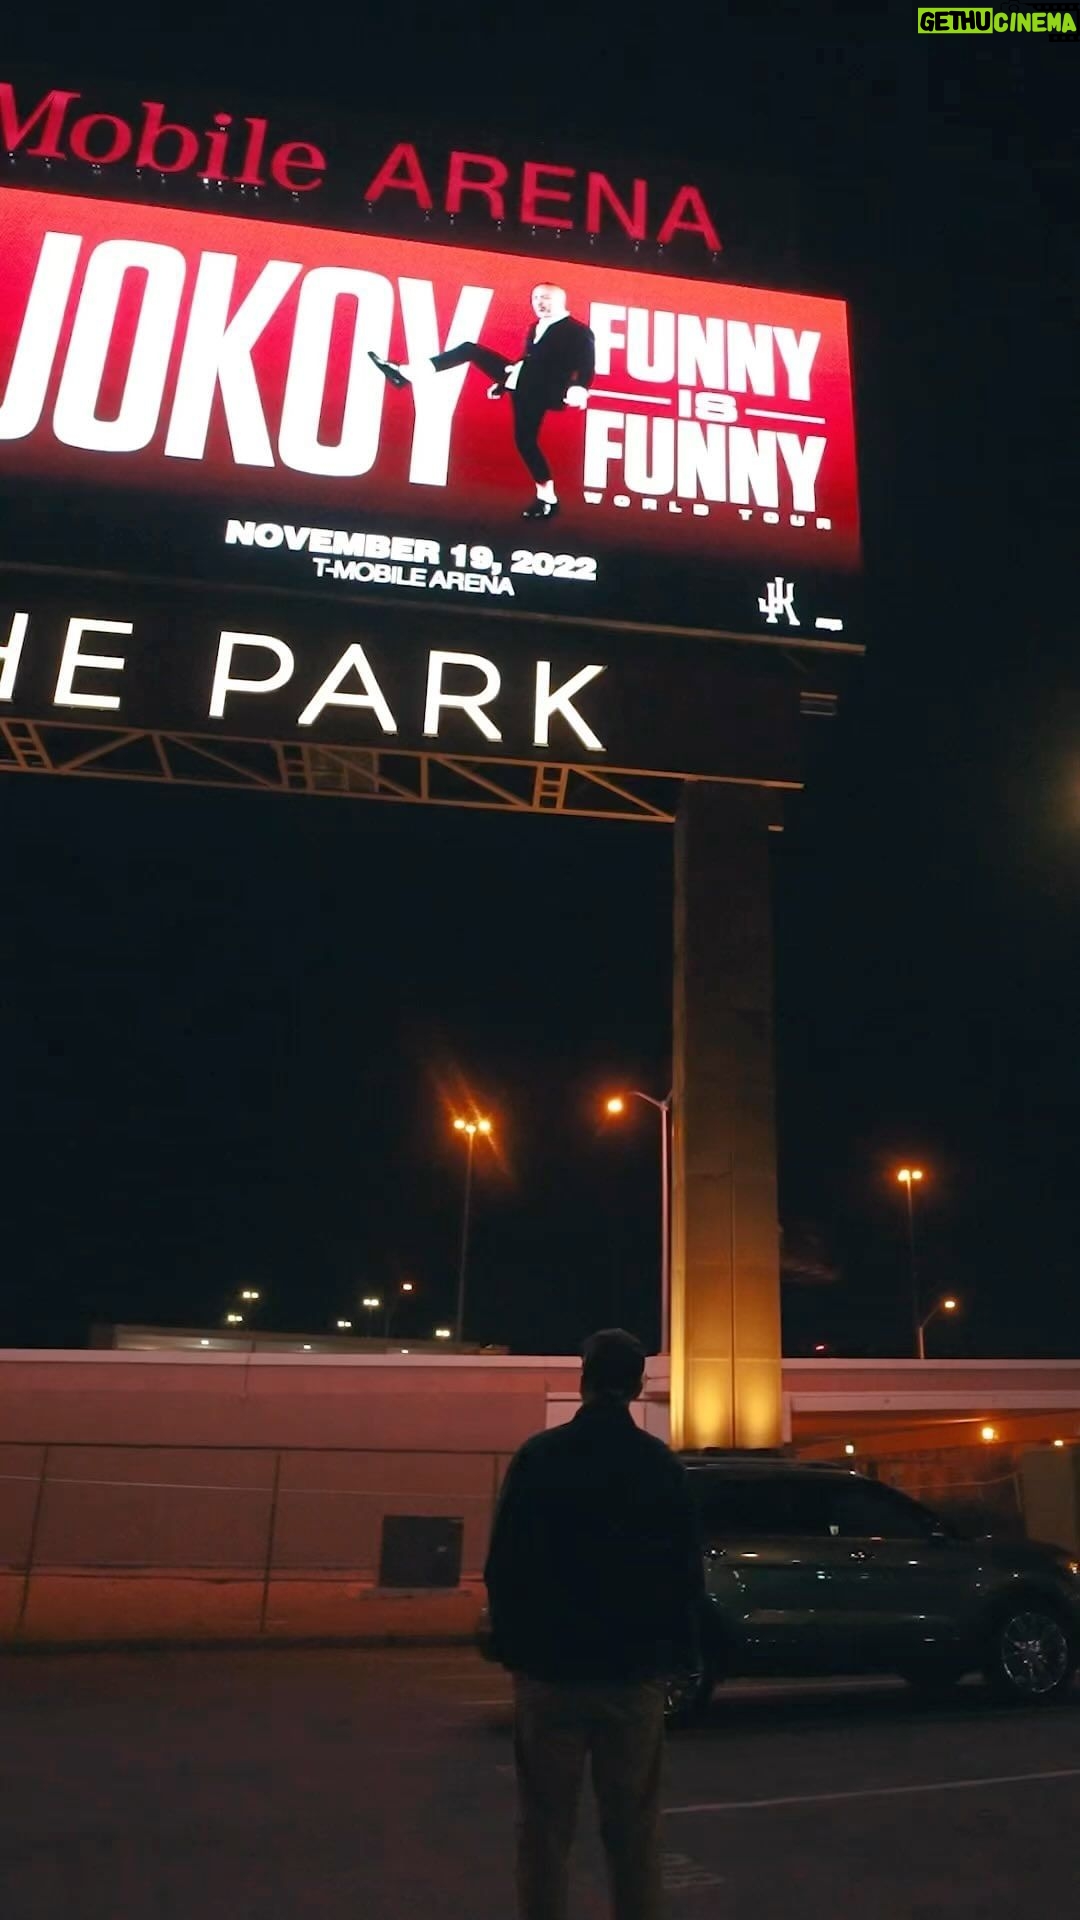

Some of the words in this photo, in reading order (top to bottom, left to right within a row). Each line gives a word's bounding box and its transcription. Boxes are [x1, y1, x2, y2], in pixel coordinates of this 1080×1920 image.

[0, 83, 327, 192] Mobile
[364, 143, 723, 252] ARENA
[0, 231, 494, 487] JOKOY
[590, 301, 821, 402] FUNNY
[678, 391, 739, 424] IS
[583, 409, 827, 513] FUNNY
[583, 491, 710, 517] WORLD
[738, 508, 832, 531] TOUR
[225, 519, 440, 565] NOVEMBER
[450, 543, 502, 576] 19,
[511, 549, 598, 581] 2022
[313, 557, 428, 589] T-MOBILE
[429, 573, 516, 597] ARENA
[208, 630, 607, 752] PARK
